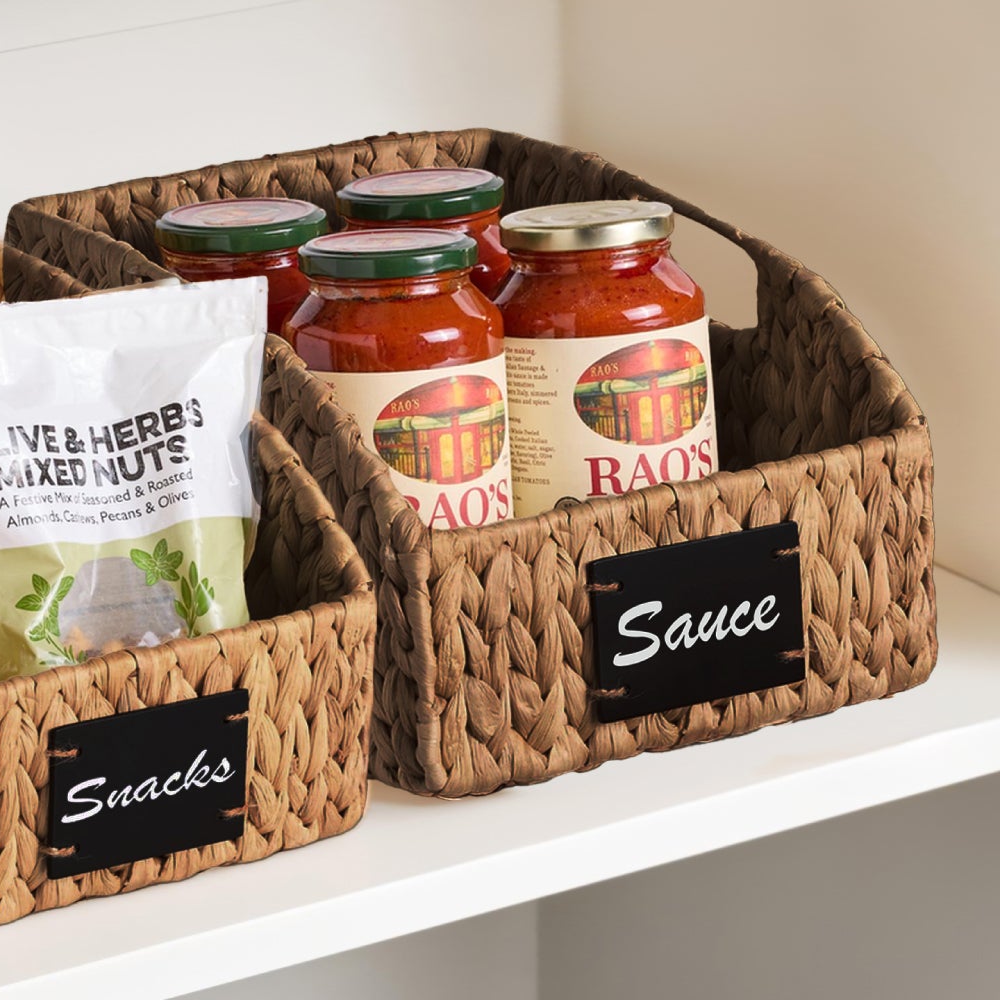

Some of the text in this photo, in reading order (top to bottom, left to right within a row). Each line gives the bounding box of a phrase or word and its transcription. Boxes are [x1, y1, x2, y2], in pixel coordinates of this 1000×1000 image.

[590, 362, 619, 378] RAO'S
[64, 426, 86, 454] &
[89, 398, 204, 454] HERBS
[391, 398, 420, 413] RAO'S
[92, 434, 190, 487] NUTS
[584, 439, 712, 497] RAO'S
[14, 493, 53, 507] Festive
[54, 491, 72, 504] Mix
[81, 488, 131, 506] Seasoned
[135, 487, 145, 498] &
[147, 468, 194, 493] Roasted
[100, 509, 142, 523] Pecans
[145, 502, 155, 514] &
[157, 489, 195, 508] Olives
[613, 595, 780, 667] Sauce
[61, 750, 236, 824] Snacks
